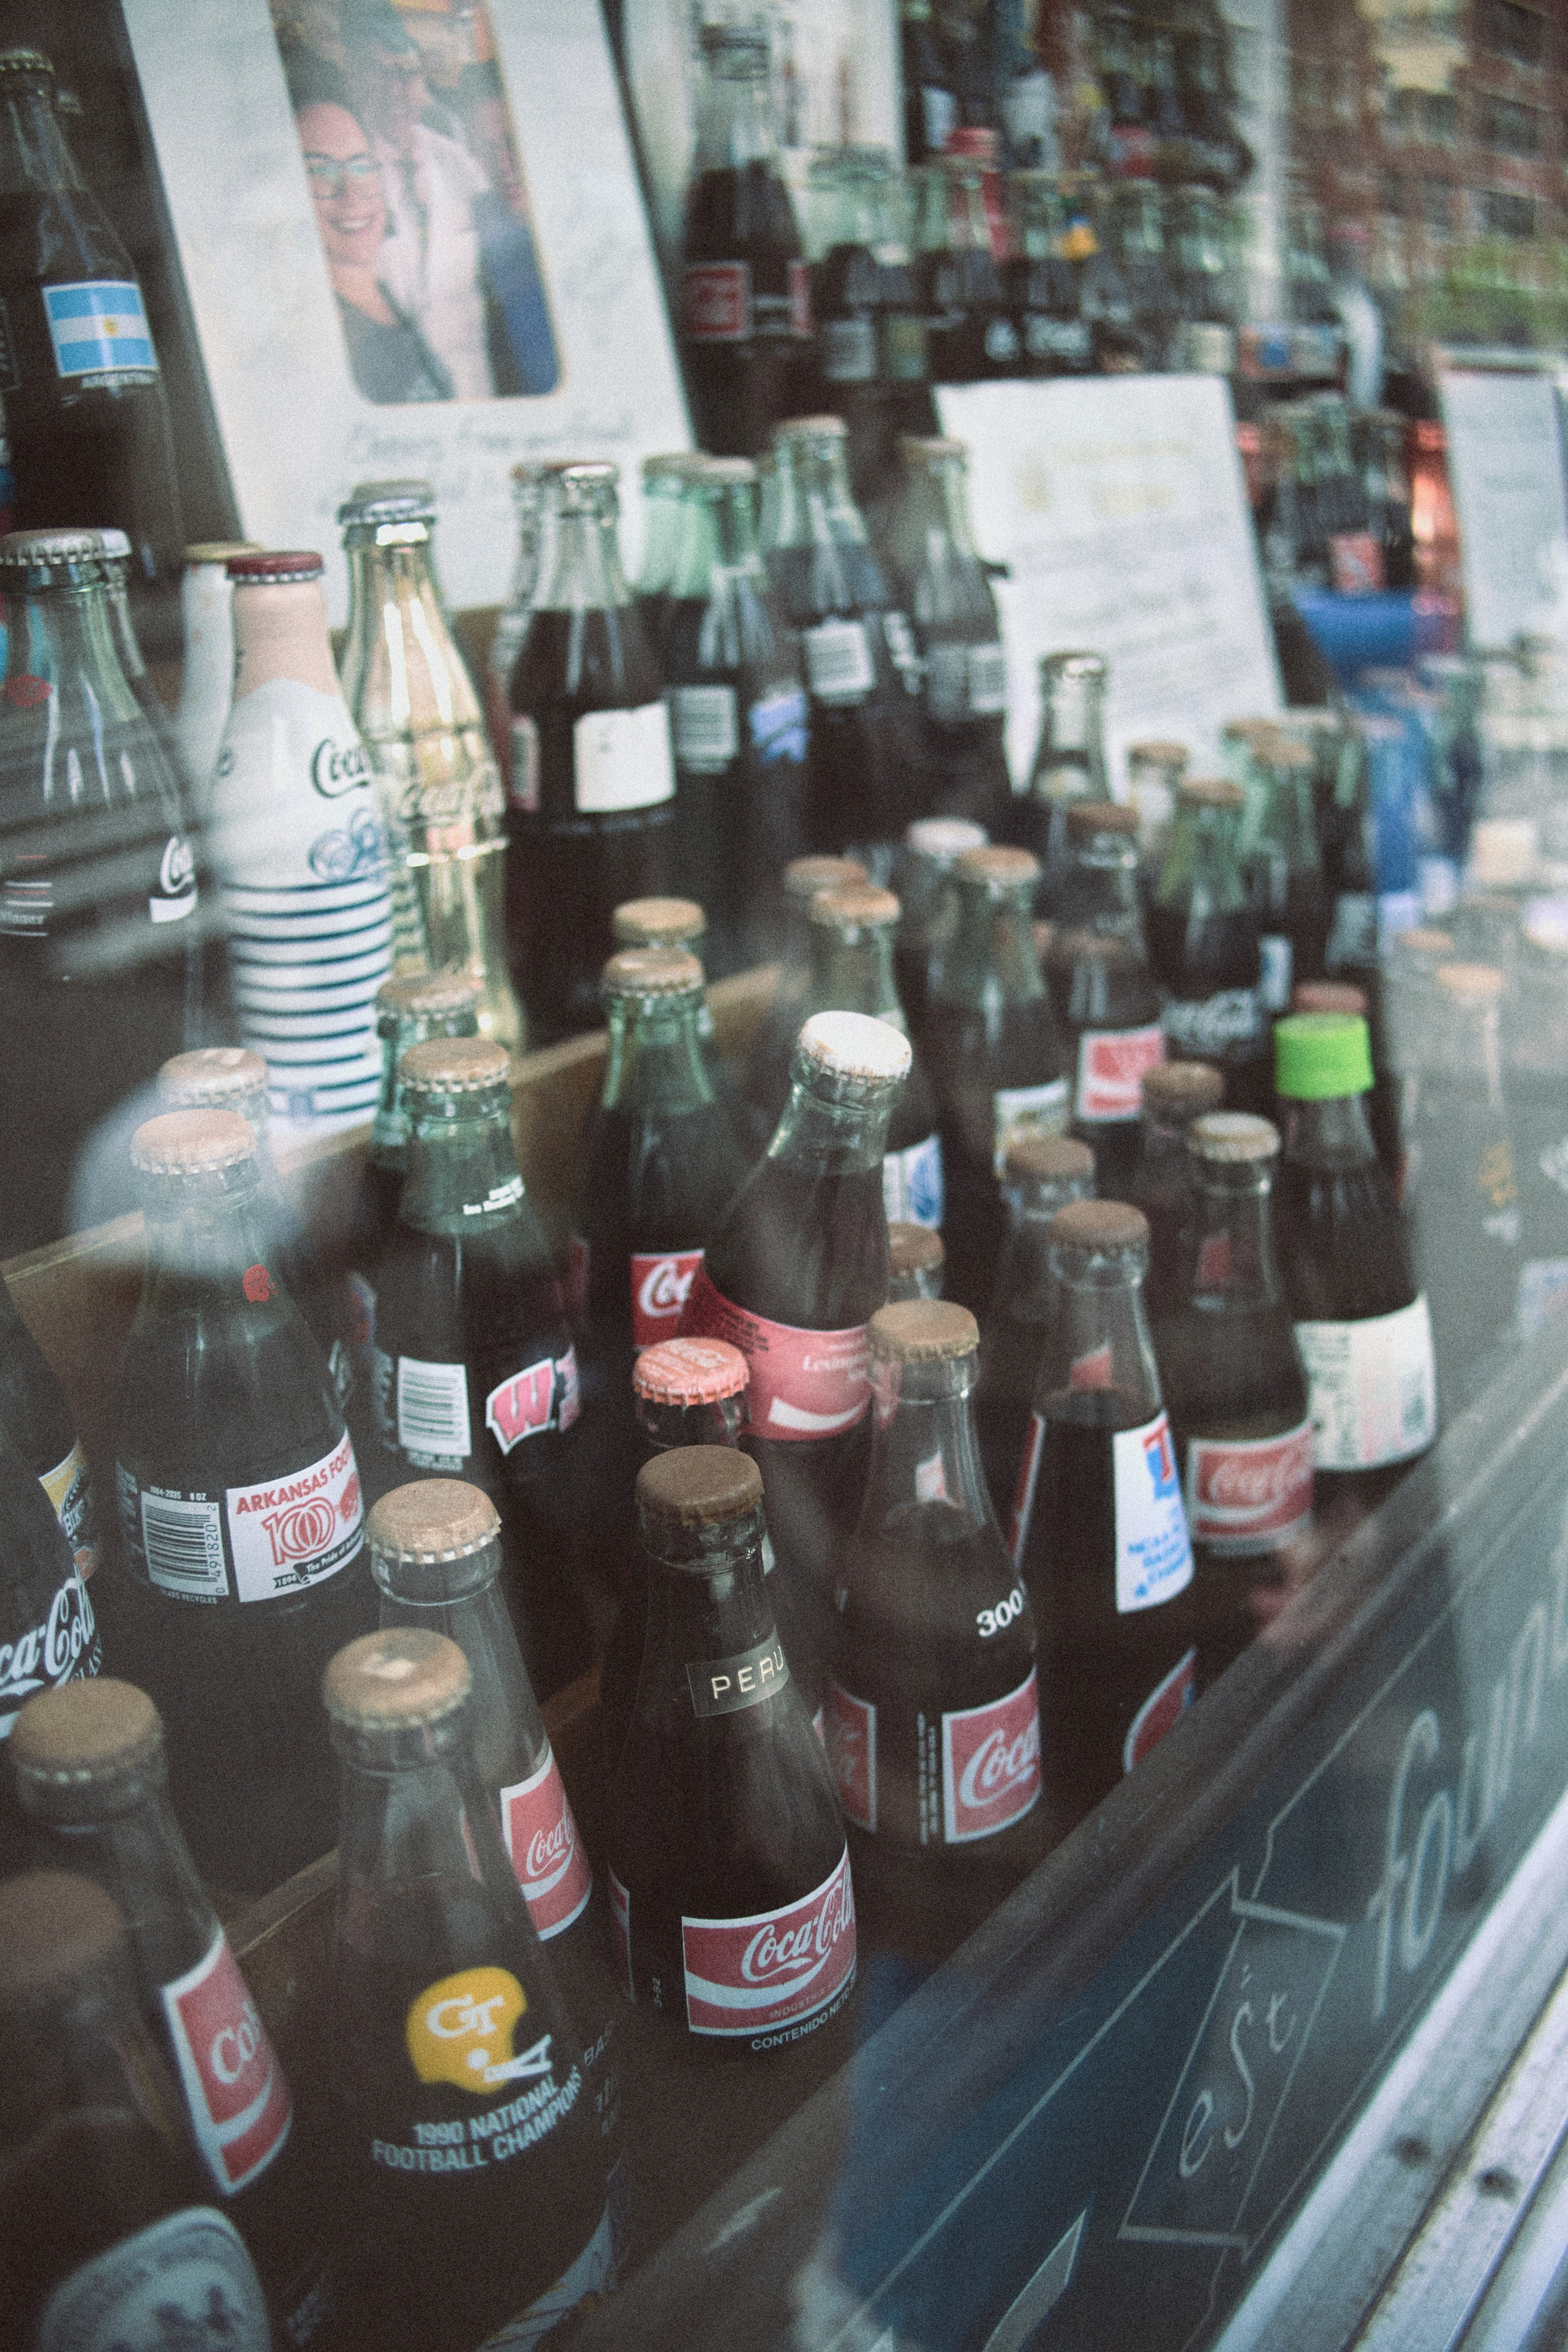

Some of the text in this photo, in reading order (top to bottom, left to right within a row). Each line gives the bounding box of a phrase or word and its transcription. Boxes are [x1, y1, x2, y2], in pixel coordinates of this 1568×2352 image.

[236, 1468, 328, 1515] ARKANSAS
[262, 1496, 336, 1566] 100
[976, 1589, 1024, 1637] 300
[710, 1645, 785, 1700] PERU
[751, 2010, 828, 2051] CONTENIDO
[412, 2122, 465, 2146] 1990
[469, 2074, 559, 2140] NATIONAL
[372, 2139, 489, 2173] FOOTBALL
